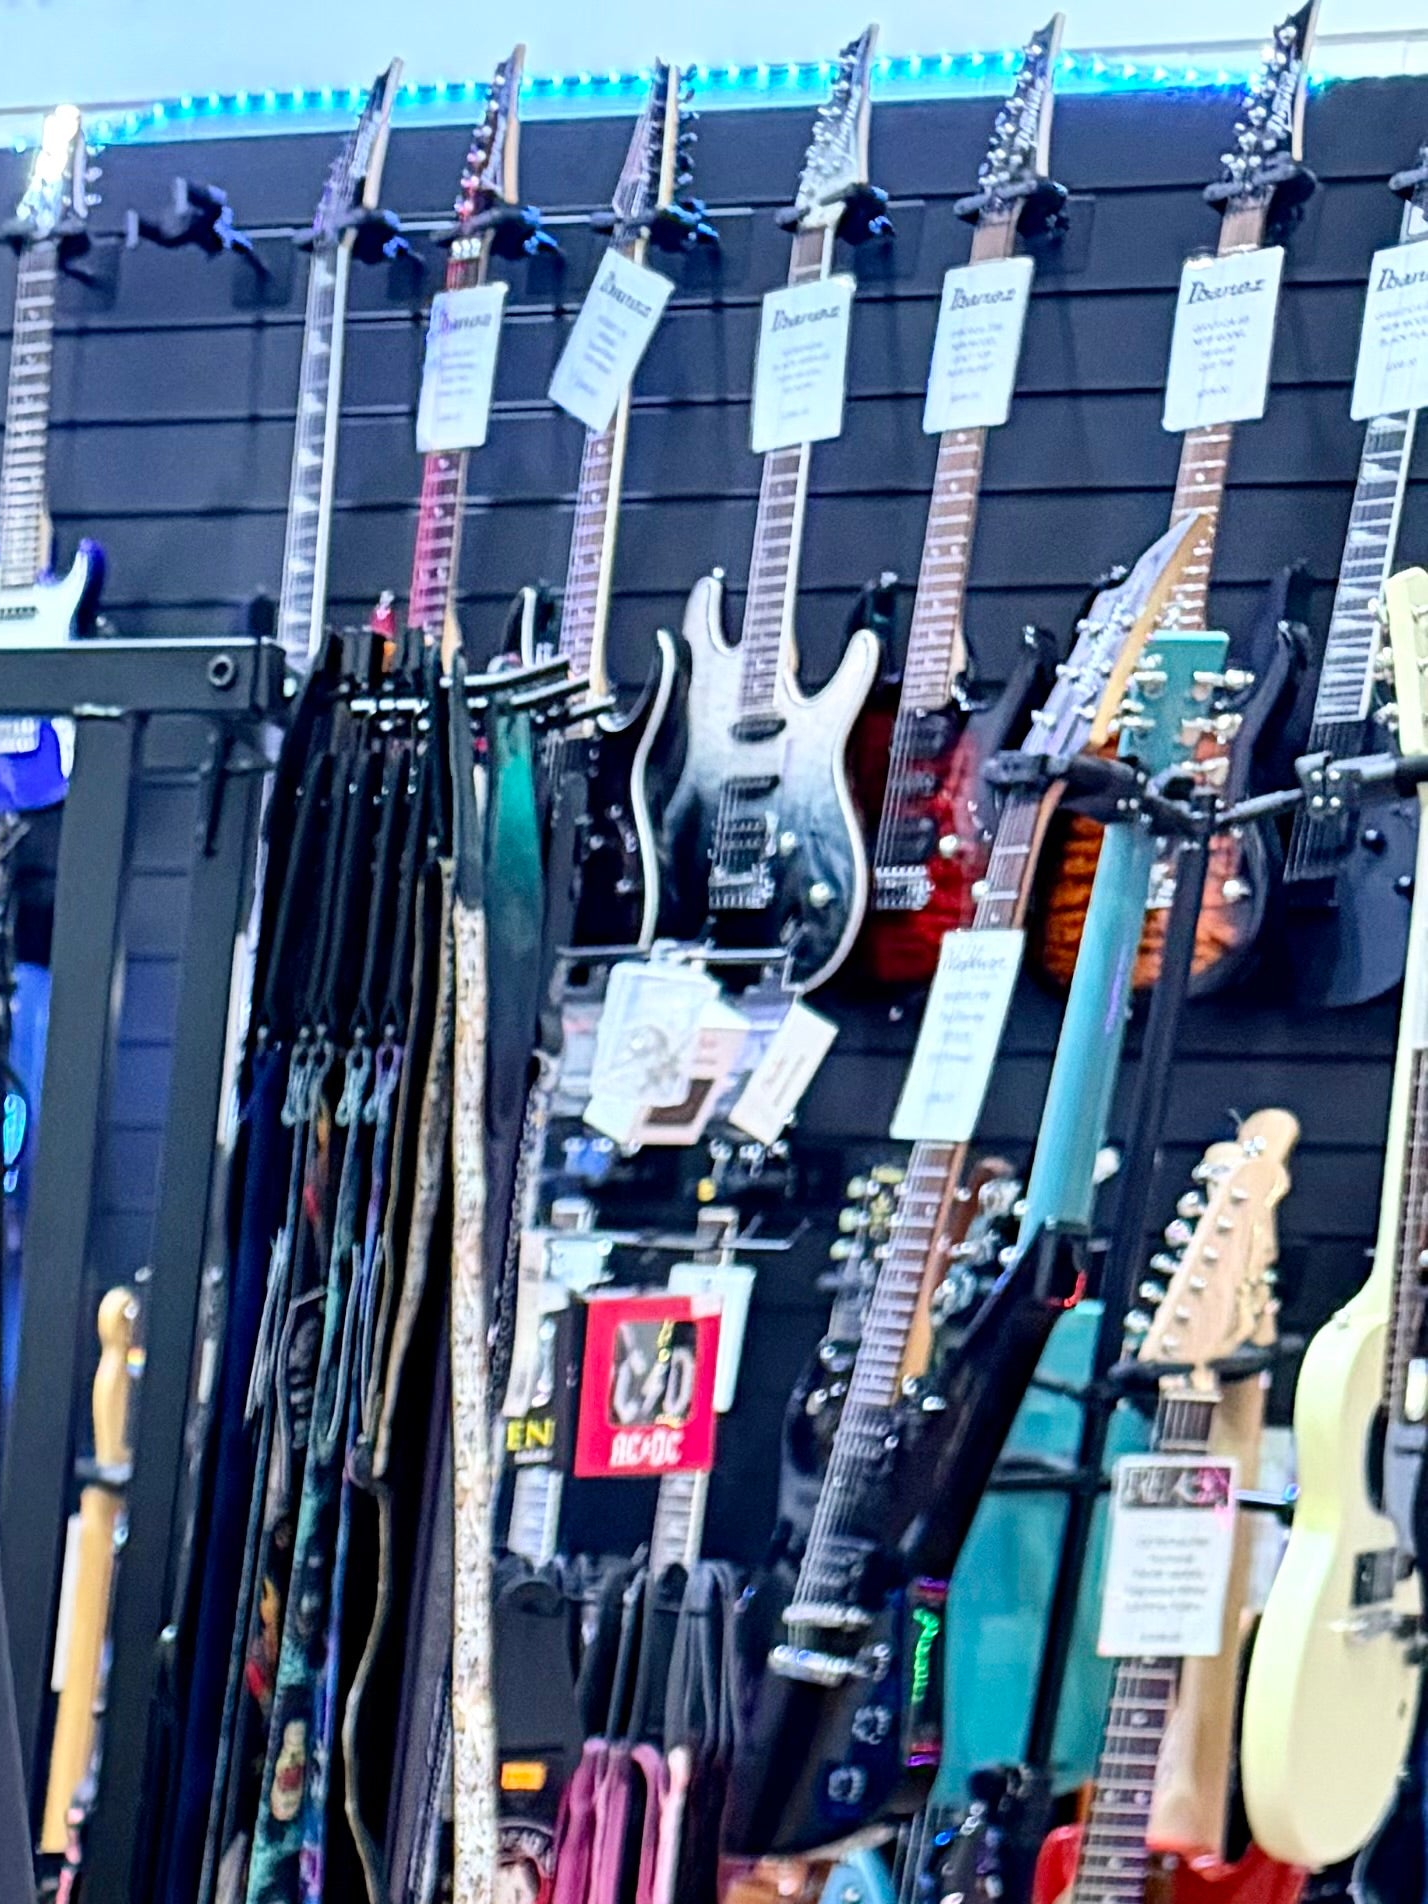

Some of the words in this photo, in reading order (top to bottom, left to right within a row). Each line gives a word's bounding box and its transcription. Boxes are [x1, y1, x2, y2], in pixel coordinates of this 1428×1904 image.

[949, 287, 1017, 312] Ibanez
[1186, 279, 1266, 305] Ibanez
[771, 305, 840, 332] Ibanez
